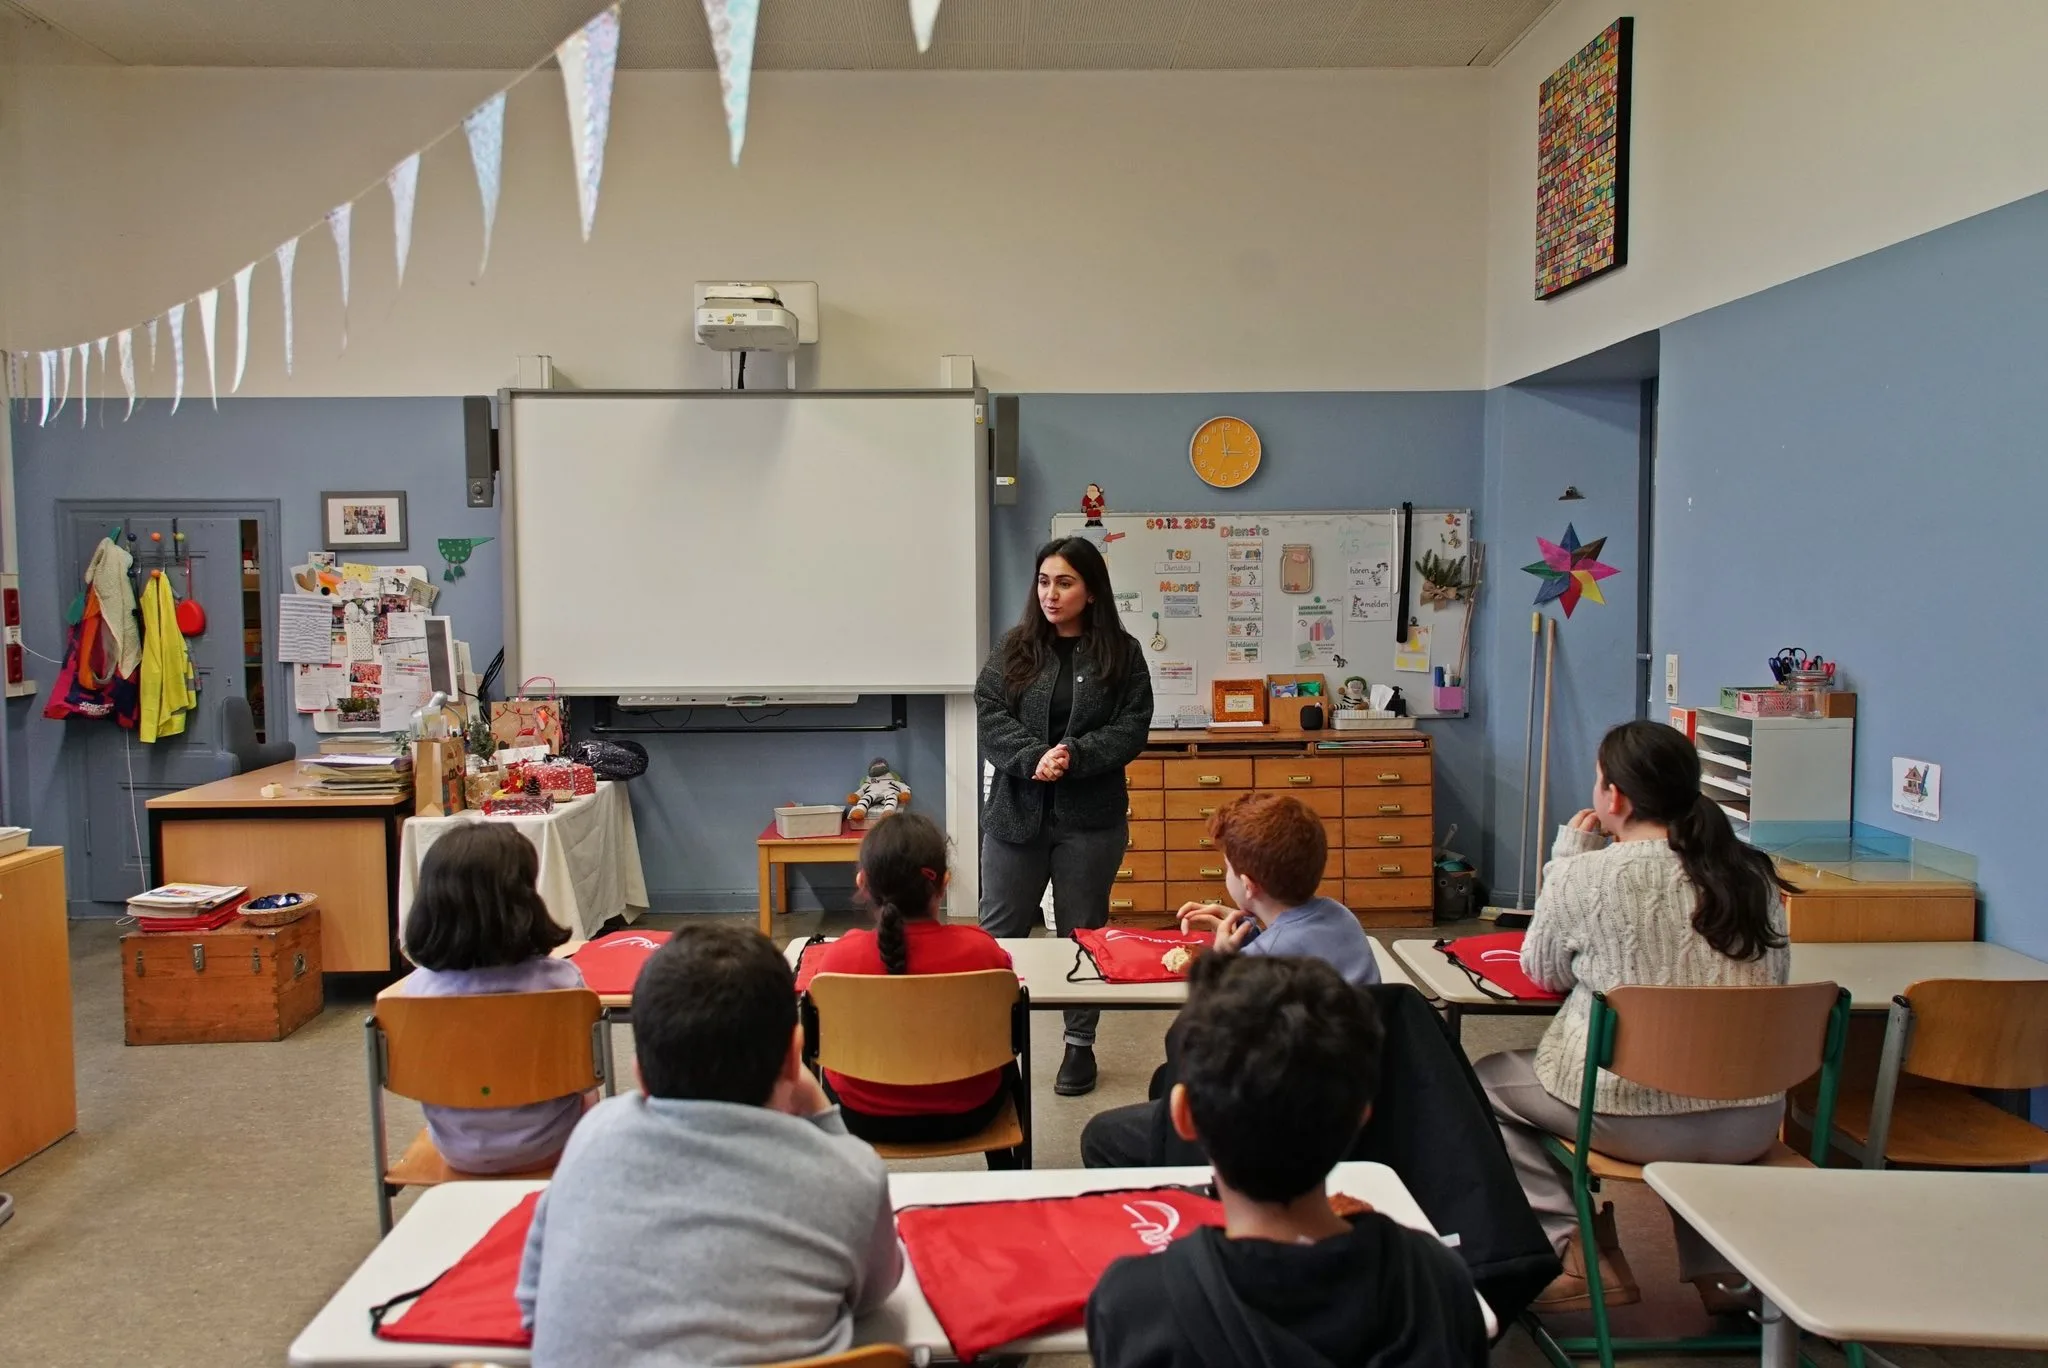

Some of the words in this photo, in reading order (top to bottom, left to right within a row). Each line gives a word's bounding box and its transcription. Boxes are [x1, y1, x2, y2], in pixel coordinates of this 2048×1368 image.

[1220, 525, 1270, 538] Dienste
[1166, 549, 1192, 561] Tag
[1230, 564, 1260, 572] Fegedienst
[1350, 566, 1370, 574] hören
[1160, 581, 1200, 592] Monat
